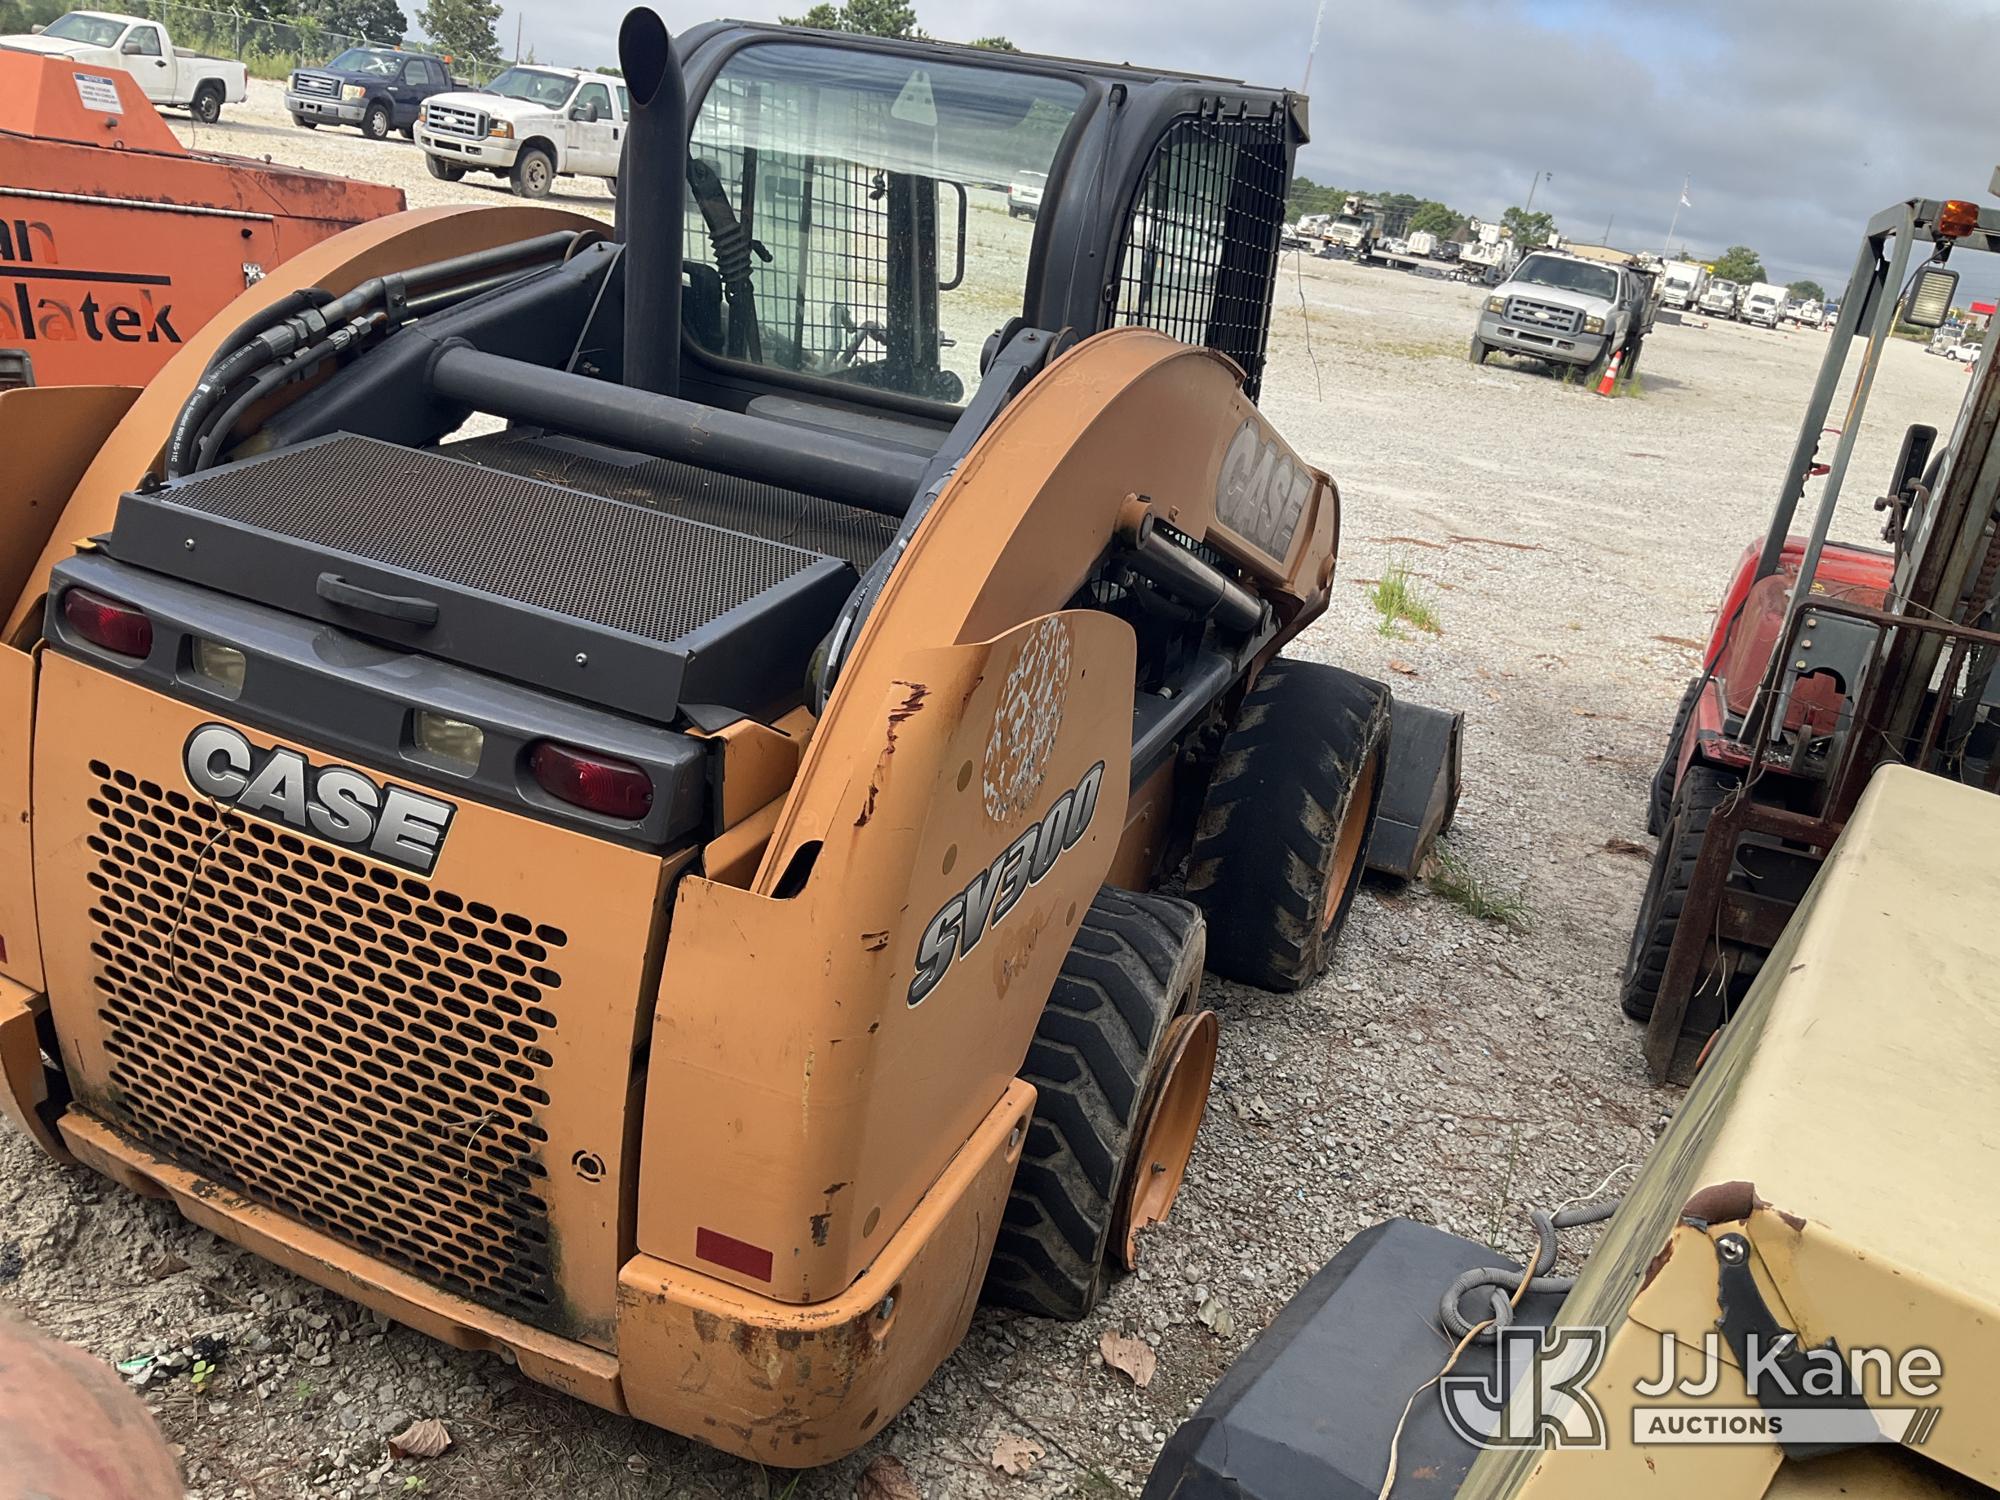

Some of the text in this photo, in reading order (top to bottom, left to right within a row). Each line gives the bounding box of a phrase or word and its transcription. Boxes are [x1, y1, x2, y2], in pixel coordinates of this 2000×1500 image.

[1219, 424, 1310, 554] CASE
[188, 728, 450, 869] CASE
[908, 761, 1104, 1008] SV300
